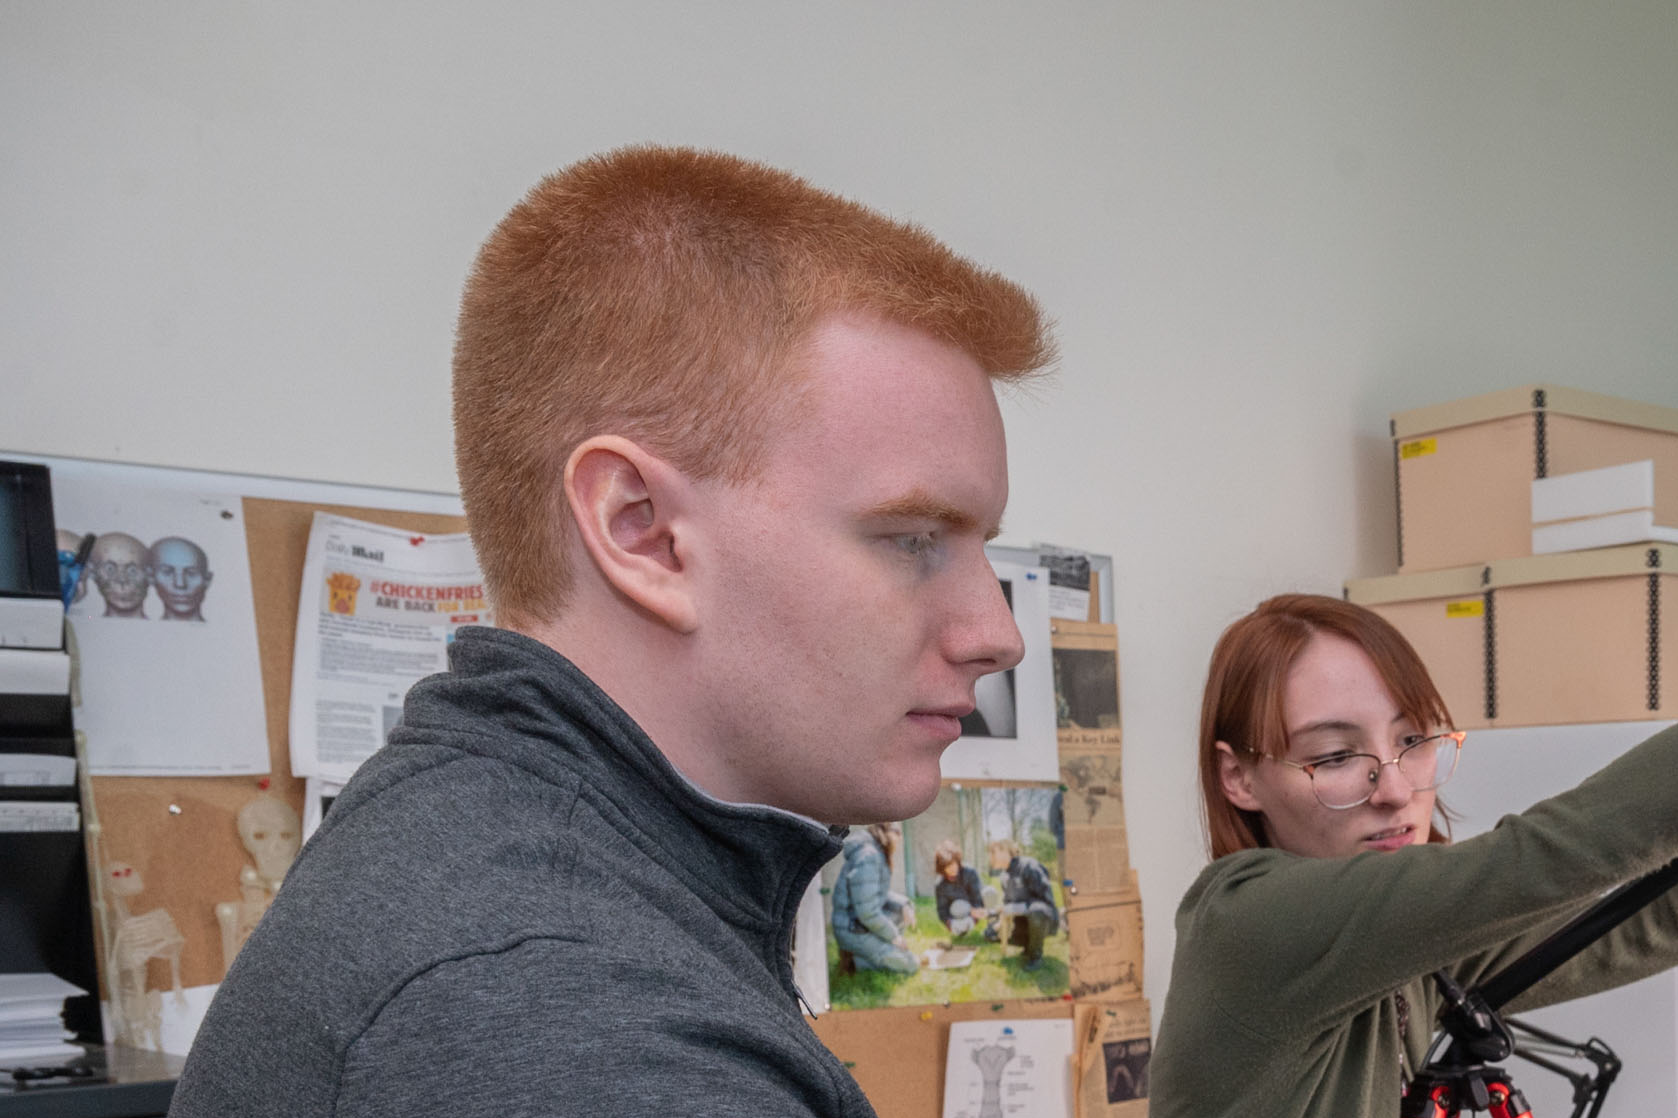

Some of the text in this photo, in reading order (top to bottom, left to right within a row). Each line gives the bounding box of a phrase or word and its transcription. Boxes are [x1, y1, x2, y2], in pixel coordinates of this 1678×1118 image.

[370, 580, 483, 600] #CHICKENFRIES
[376, 596, 399, 609] ARE
[404, 600, 434, 612] BACK
